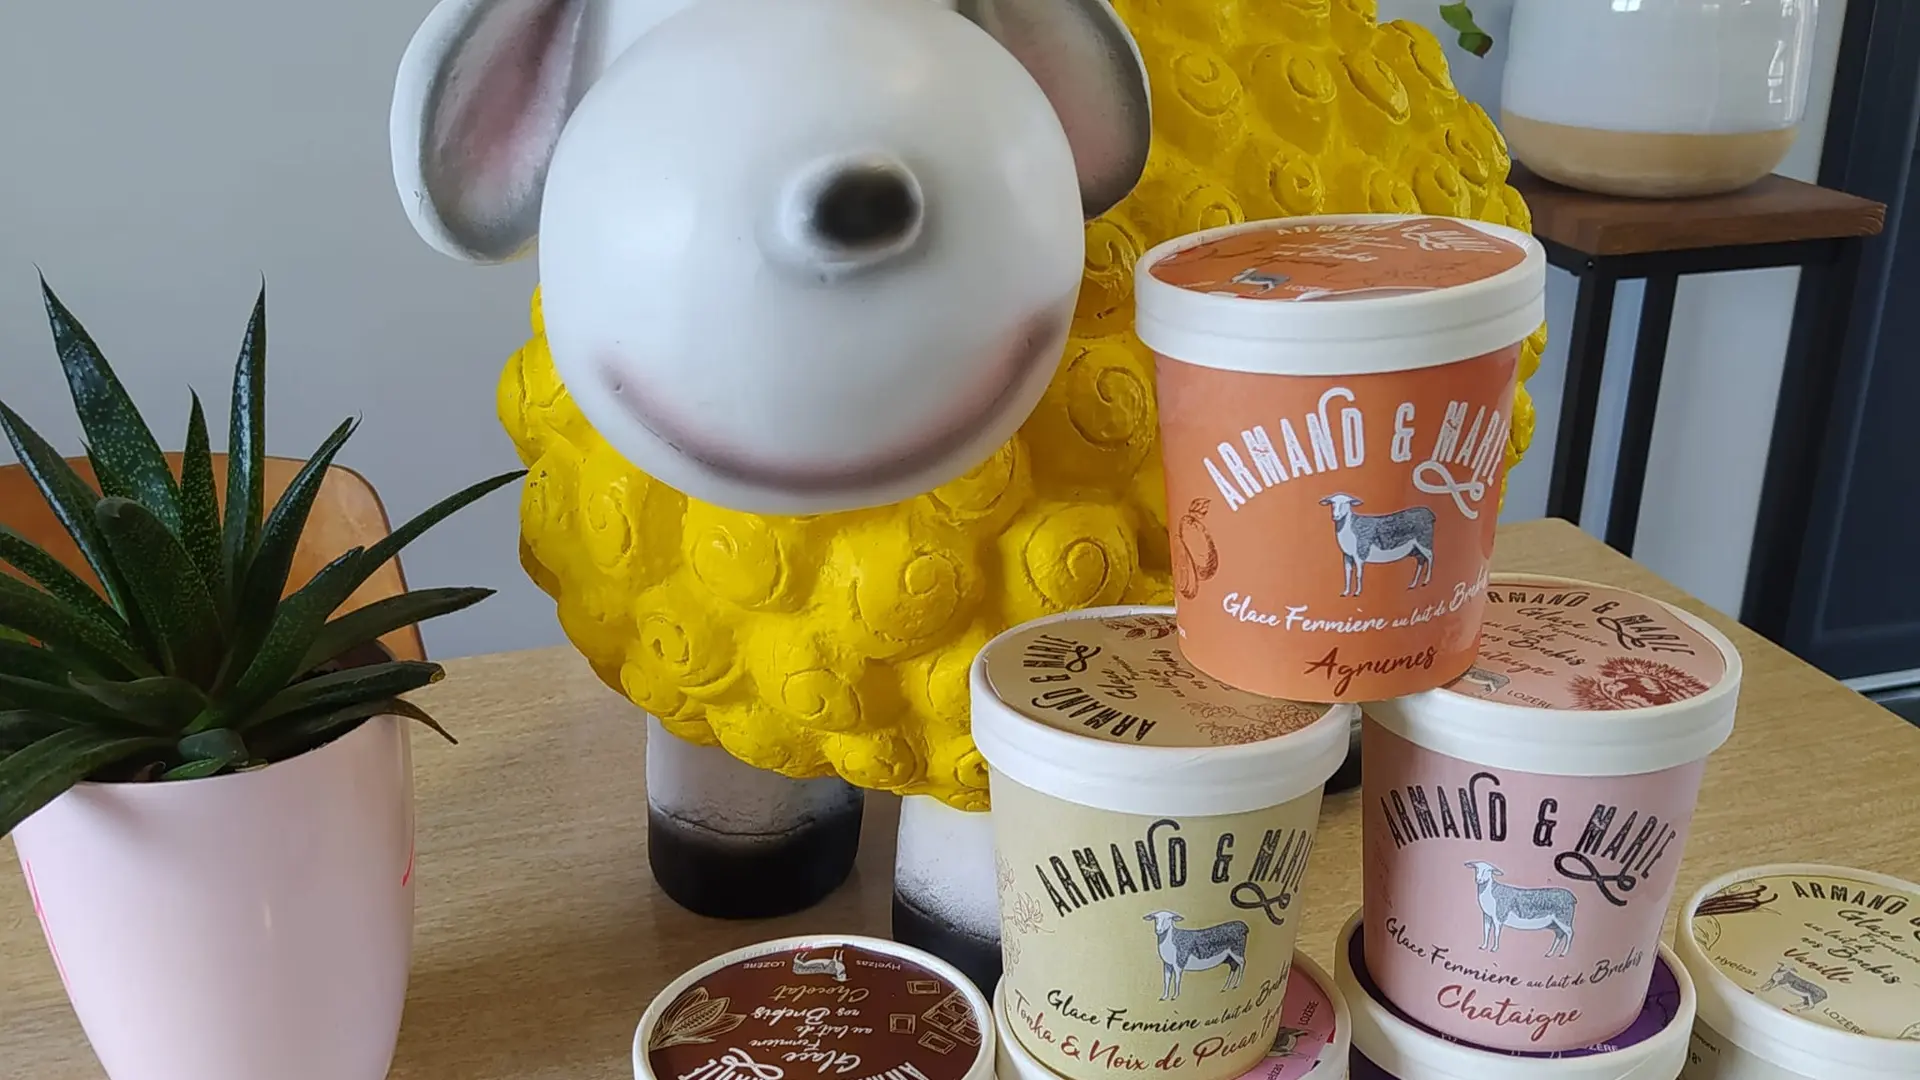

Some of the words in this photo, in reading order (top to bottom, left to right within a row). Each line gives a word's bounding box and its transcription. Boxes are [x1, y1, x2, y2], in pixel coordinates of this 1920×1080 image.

[1204, 387, 1365, 511] ARMAND
[1391, 402, 1416, 463] &
[1222, 591, 1280, 628] Glace
[1284, 604, 1388, 634] Fermière
[1391, 617, 1409, 628] au
[1410, 606, 1434, 626] lait
[1432, 600, 1447, 618] de
[1486, 591, 1590, 608] RMAND
[1592, 600, 1620, 614] &
[1516, 607, 1590, 630] Glace
[1596, 613, 1696, 658] MARIE
[1023, 633, 1102, 673] MARIE
[1508, 636, 1586, 666] Brebis
[1029, 673, 1071, 684] &
[1304, 645, 1437, 696] Agrumes
[1031, 687, 1157, 741] ARMAND
[1380, 771, 1507, 850] ARMAND
[1532, 798, 1559, 848] &
[1554, 804, 1677, 907] MARIE
[1035, 819, 1187, 918] ARMAND
[1211, 832, 1234, 883] &
[1792, 881, 1910, 915] ARMAND
[1824, 930, 1857, 944] lait
[1837, 909, 1905, 942] Glace
[1385, 917, 1427, 958] Glace
[1429, 943, 1522, 988] Fermière
[1526, 978, 1544, 990] au
[1545, 974, 1571, 990] lait
[1571, 971, 1586, 987] de
[1588, 947, 1645, 985] Brebis
[1784, 948, 1853, 984] Vanille
[1827, 945, 1901, 984] Brebis
[769, 984, 870, 1003] Chocolat
[751, 1005, 834, 1027] Brebis
[837, 1008, 861, 1018] nos
[1047, 989, 1100, 1028] Glace
[1105, 1007, 1201, 1034] Fermière
[1203, 1017, 1219, 1028] au
[1221, 1005, 1243, 1024] lait
[1241, 998, 1253, 1014] de
[1437, 984, 1583, 1042] Chataigne
[823, 1024, 853, 1038] lait
[852, 1026, 874, 1035] au
[1014, 988, 1056, 1043] Tonka
[1060, 1035, 1080, 1060] &
[1088, 1038, 1150, 1072] Noix
[1153, 1045, 1187, 1071] de
[1192, 1030, 1260, 1068] Pécan
[780, 1047, 862, 1074] Glace
